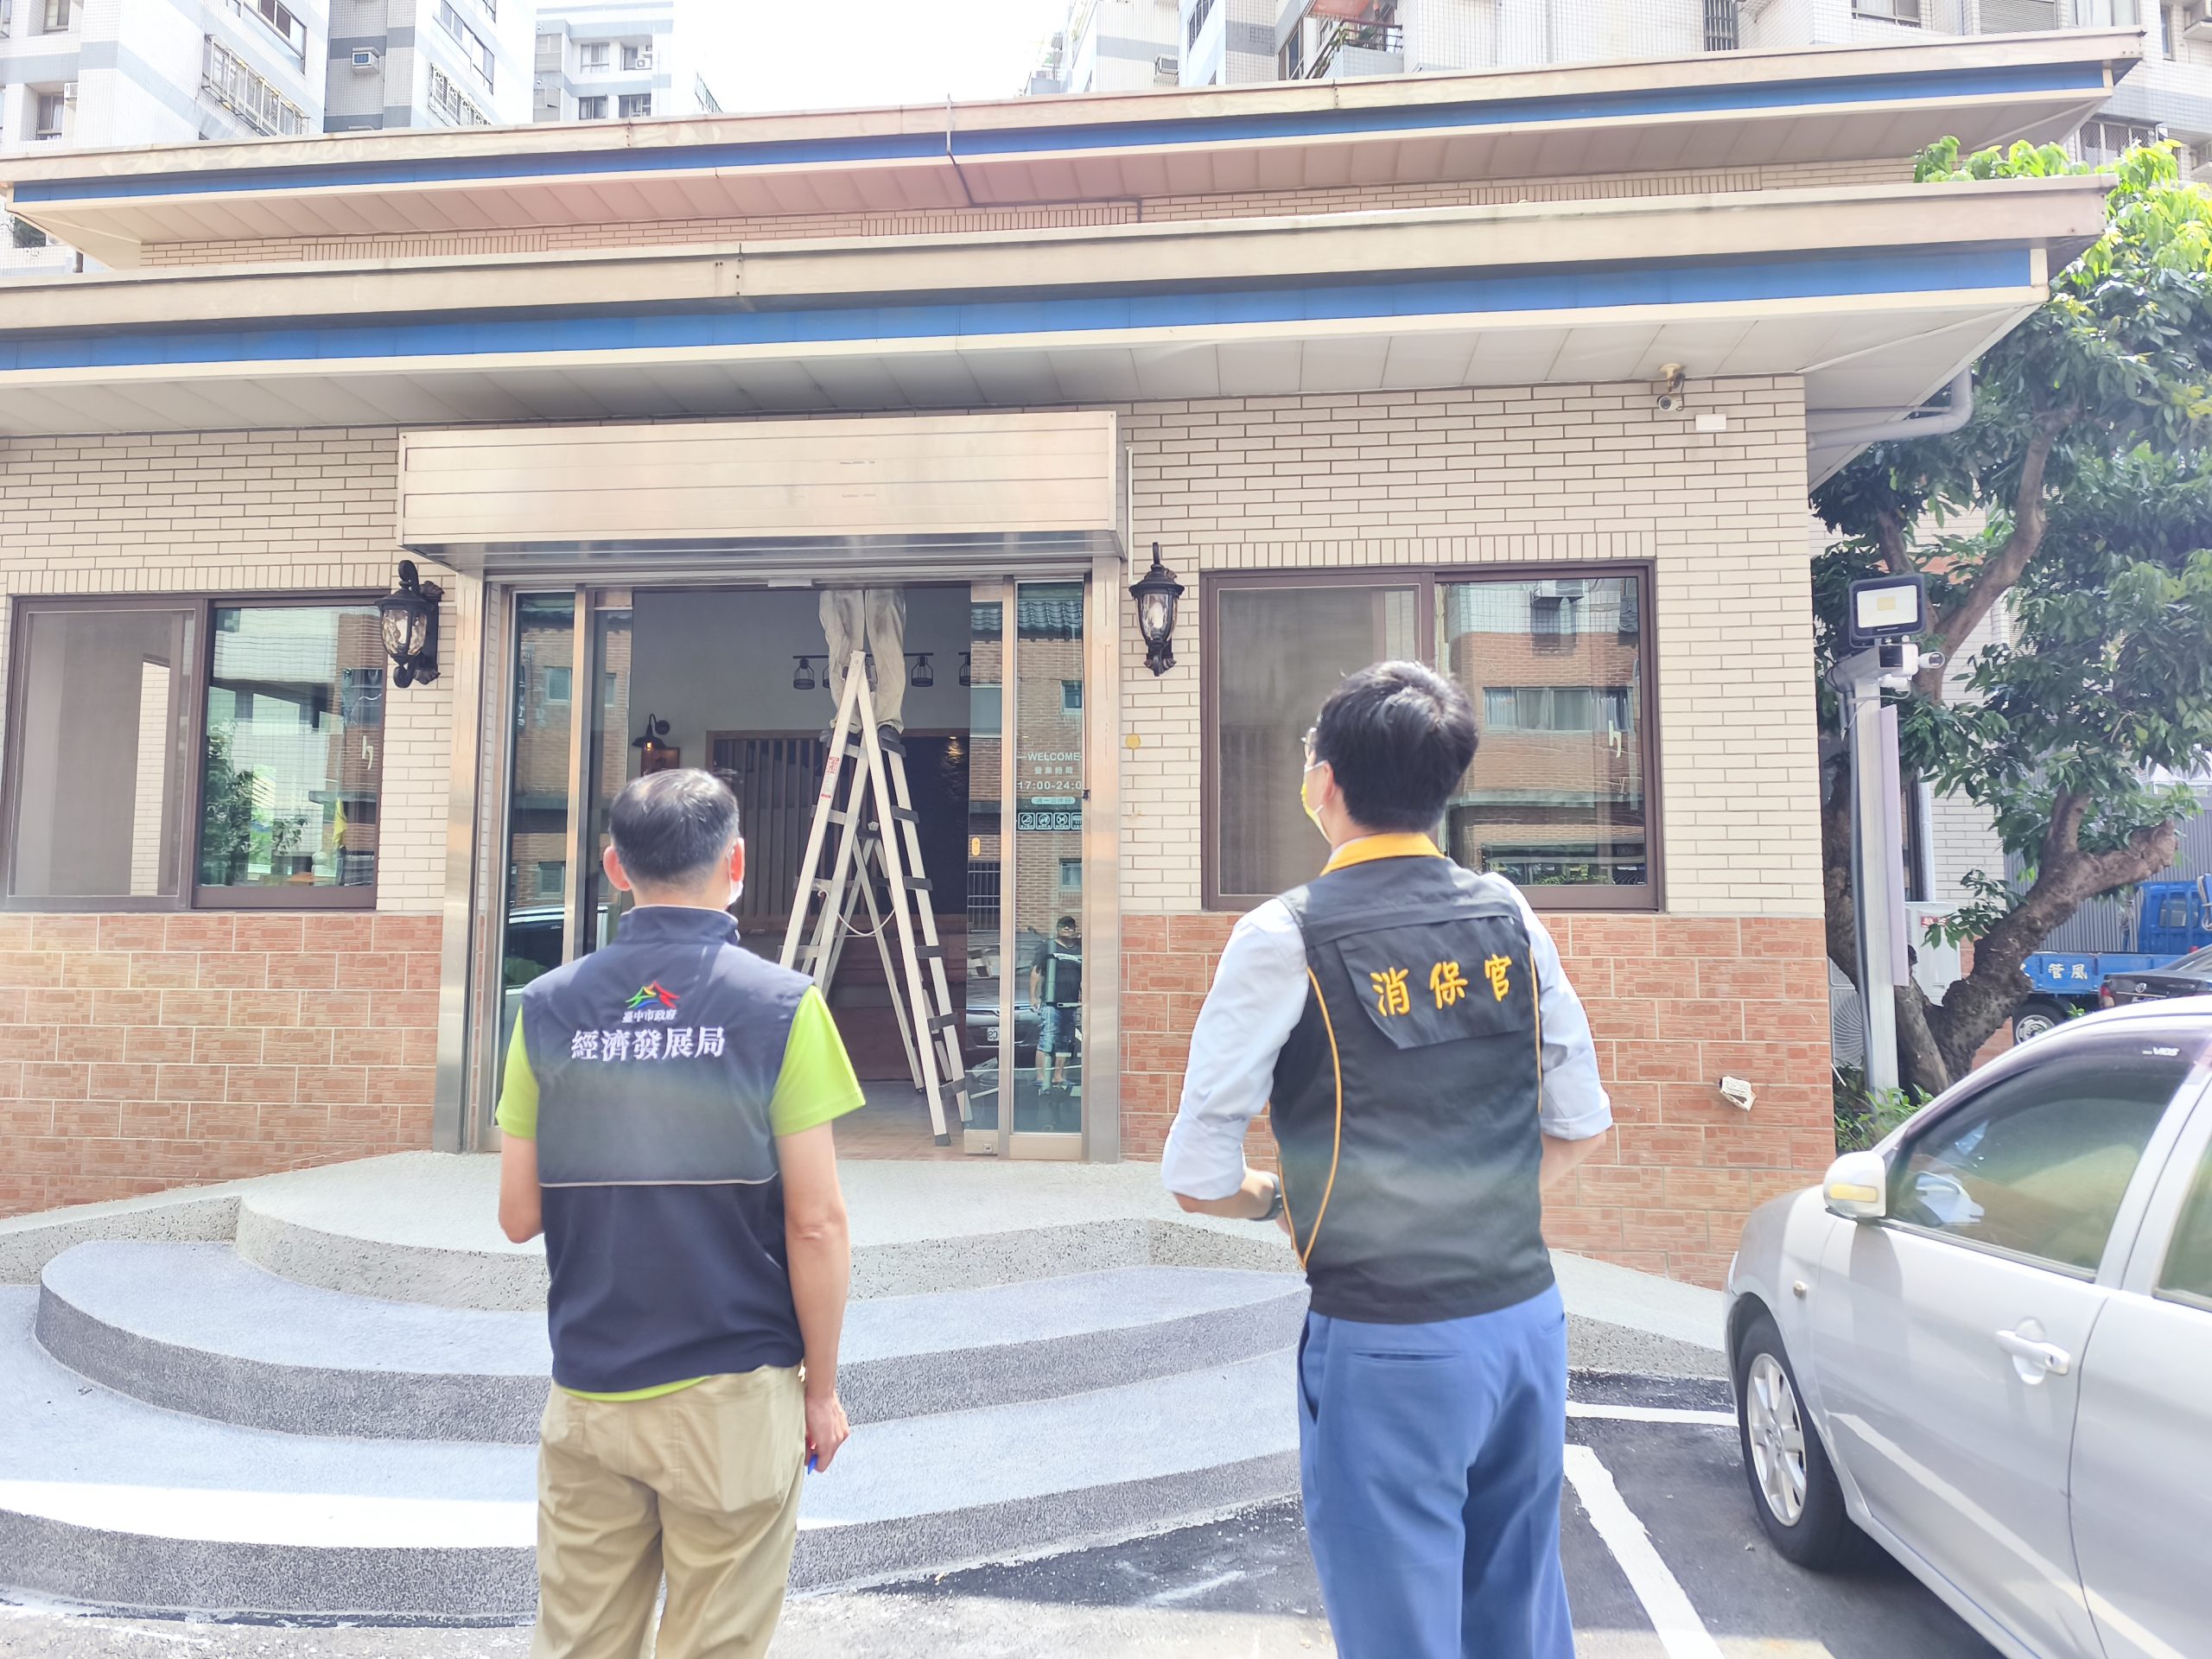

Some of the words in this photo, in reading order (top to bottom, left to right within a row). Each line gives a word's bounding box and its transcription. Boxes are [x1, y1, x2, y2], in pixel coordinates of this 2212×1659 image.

[1027, 753, 1081, 761] WELCOME
[1370, 953, 1512, 1017] 消保官
[622, 1008, 677, 1024] 臺中市政府
[571, 1027, 725, 1062] 經濟發展局
